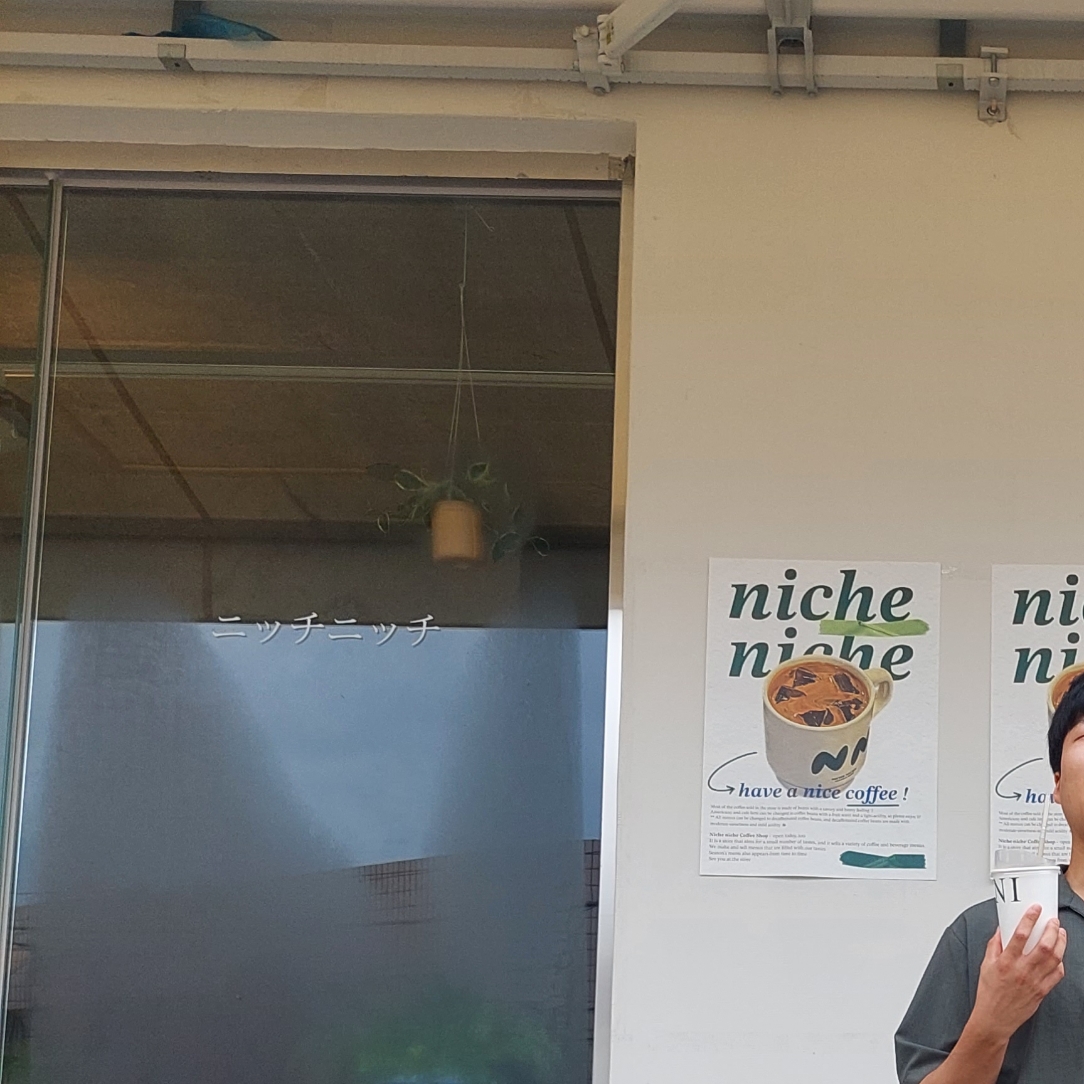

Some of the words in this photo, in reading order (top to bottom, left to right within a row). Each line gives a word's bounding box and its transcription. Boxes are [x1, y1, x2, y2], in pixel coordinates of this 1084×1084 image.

[729, 568, 913, 622] niche
[212, 612, 441, 647] ニッチニッチ
[738, 783, 782, 798] have
[786, 787, 798, 798] a
[803, 784, 841, 799] nice
[845, 785, 898, 804] coffee
